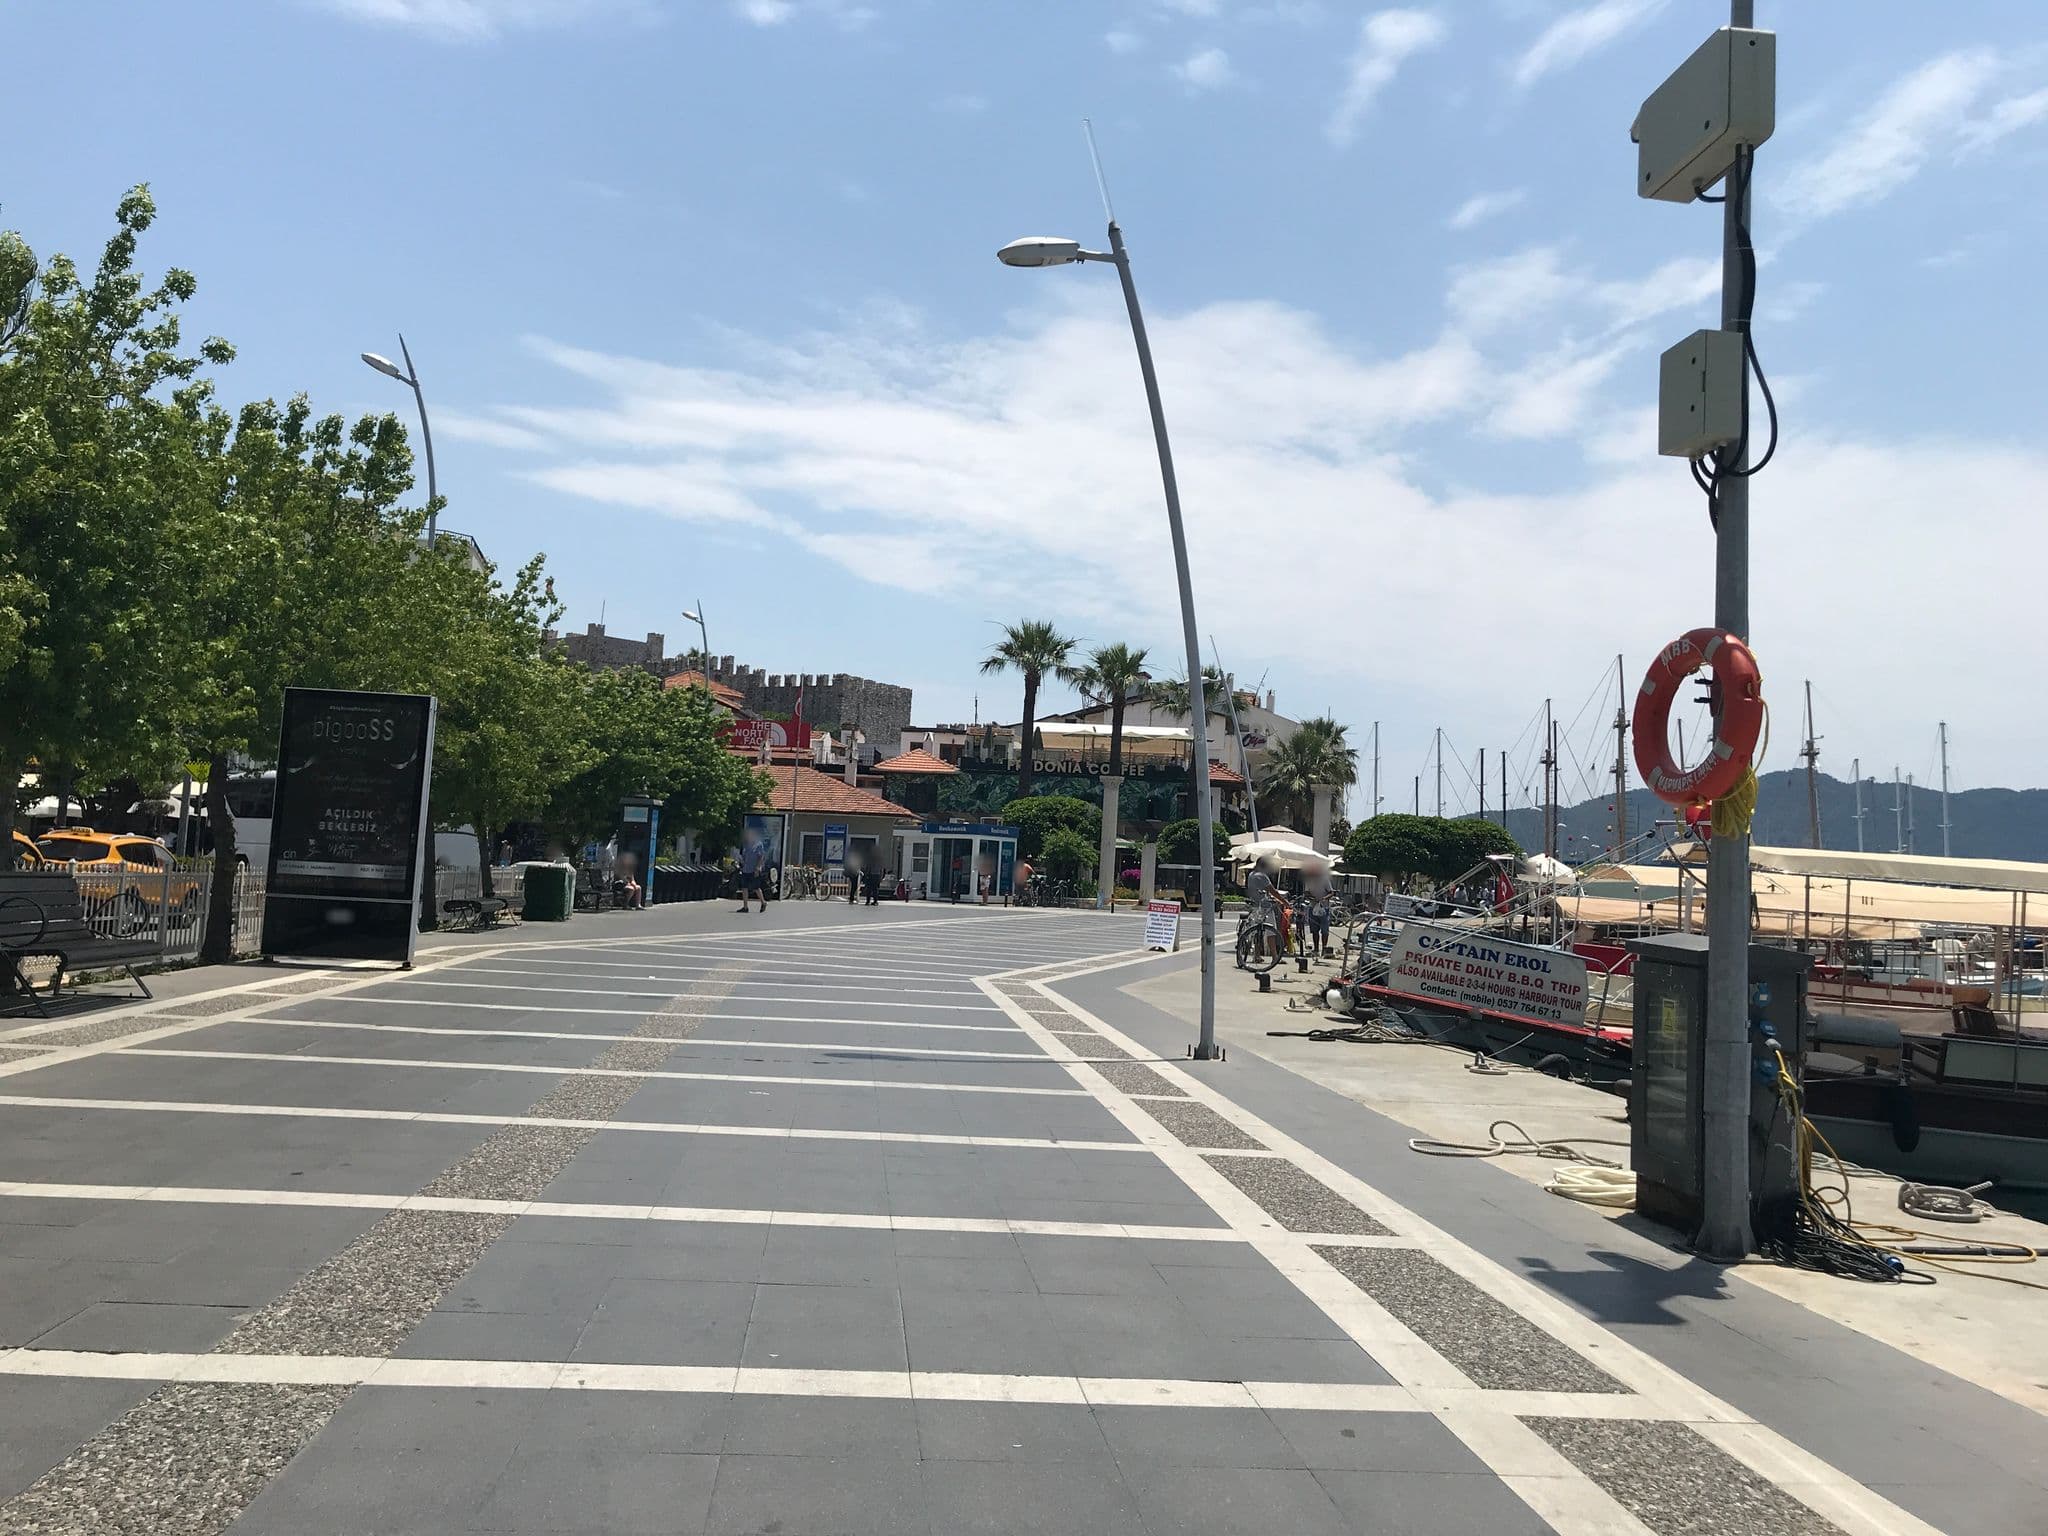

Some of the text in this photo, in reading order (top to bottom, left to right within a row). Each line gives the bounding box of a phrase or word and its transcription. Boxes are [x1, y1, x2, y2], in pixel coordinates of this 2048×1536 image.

[750, 722, 770, 730] THE
[1088, 763, 1144, 776] COFEE
[1405, 950, 1581, 996] PRIVATE DAILY B.B.Q TRIP
[1418, 936, 1552, 974] CAPTAIN EROL
[1396, 964, 1582, 1012] ALSO AVAILABLE 2-3-4 HOURS HARBOUR TOUR
[1420, 982, 1562, 1020] Contact: (mobile) 0537 764 67 13
